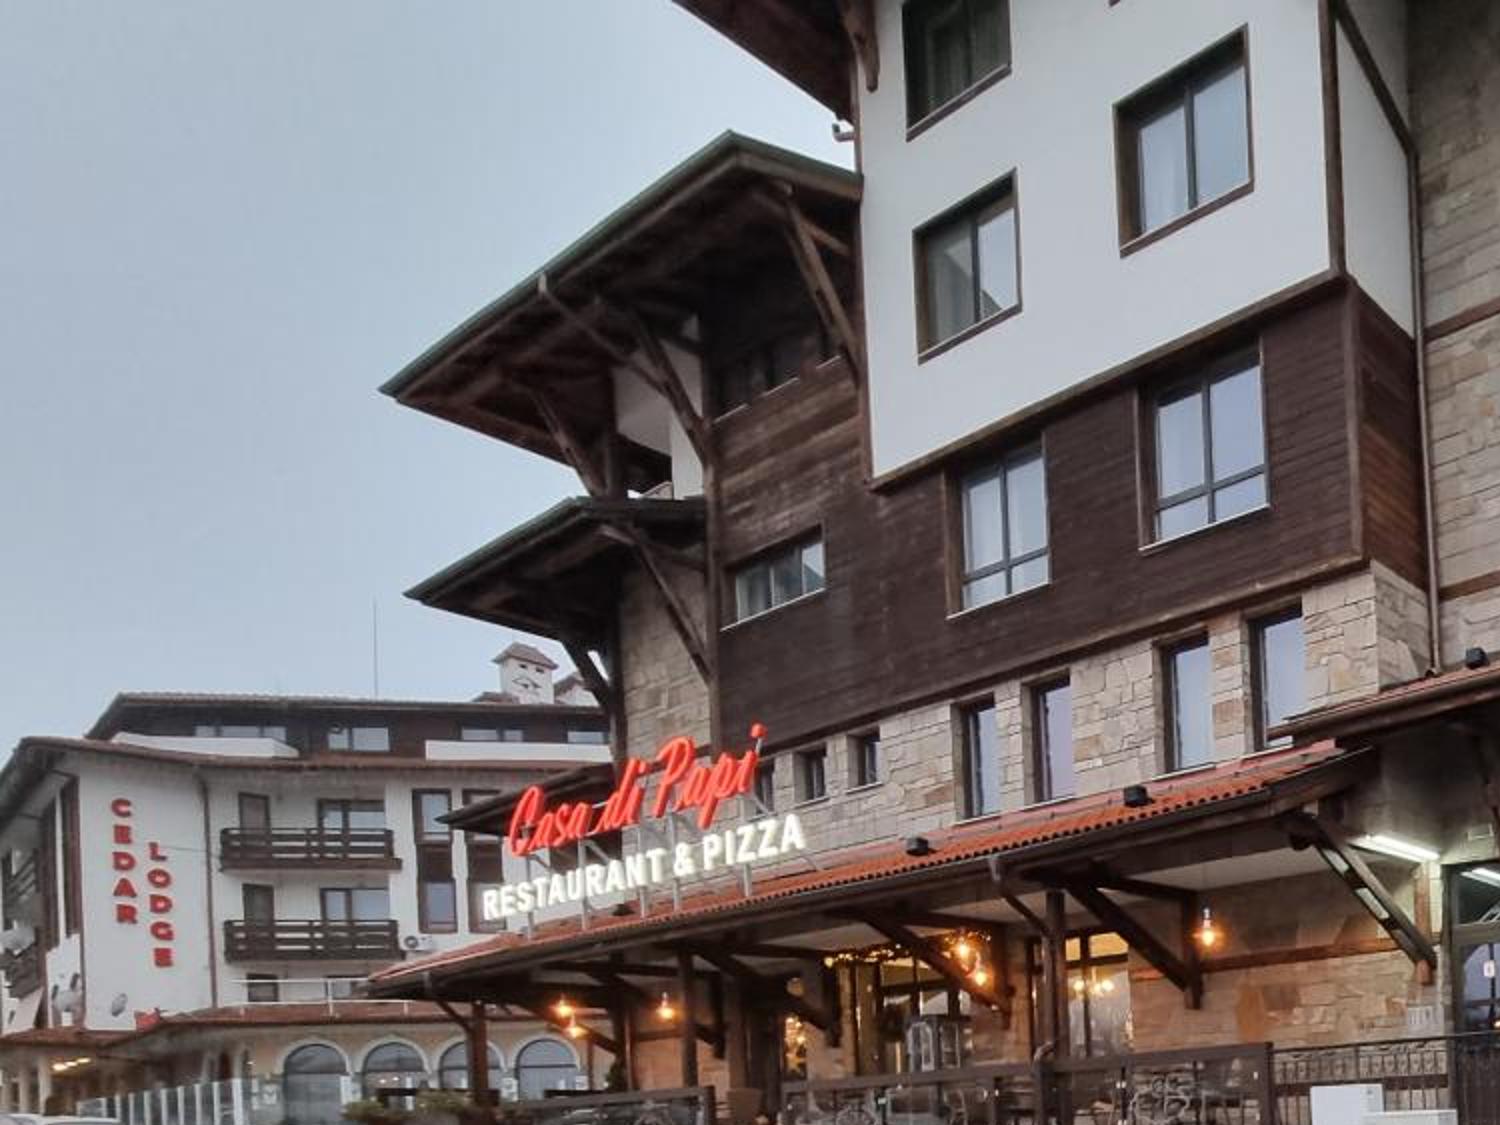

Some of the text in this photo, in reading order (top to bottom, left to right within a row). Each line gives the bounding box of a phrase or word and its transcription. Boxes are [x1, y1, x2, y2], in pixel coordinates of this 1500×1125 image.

[508, 723, 768, 857] Casa di Papi
[111, 798, 137, 925] CEDAR
[147, 841, 174, 968] LODGE
[482, 813, 807, 921] RESTAURANT & PIZZA
